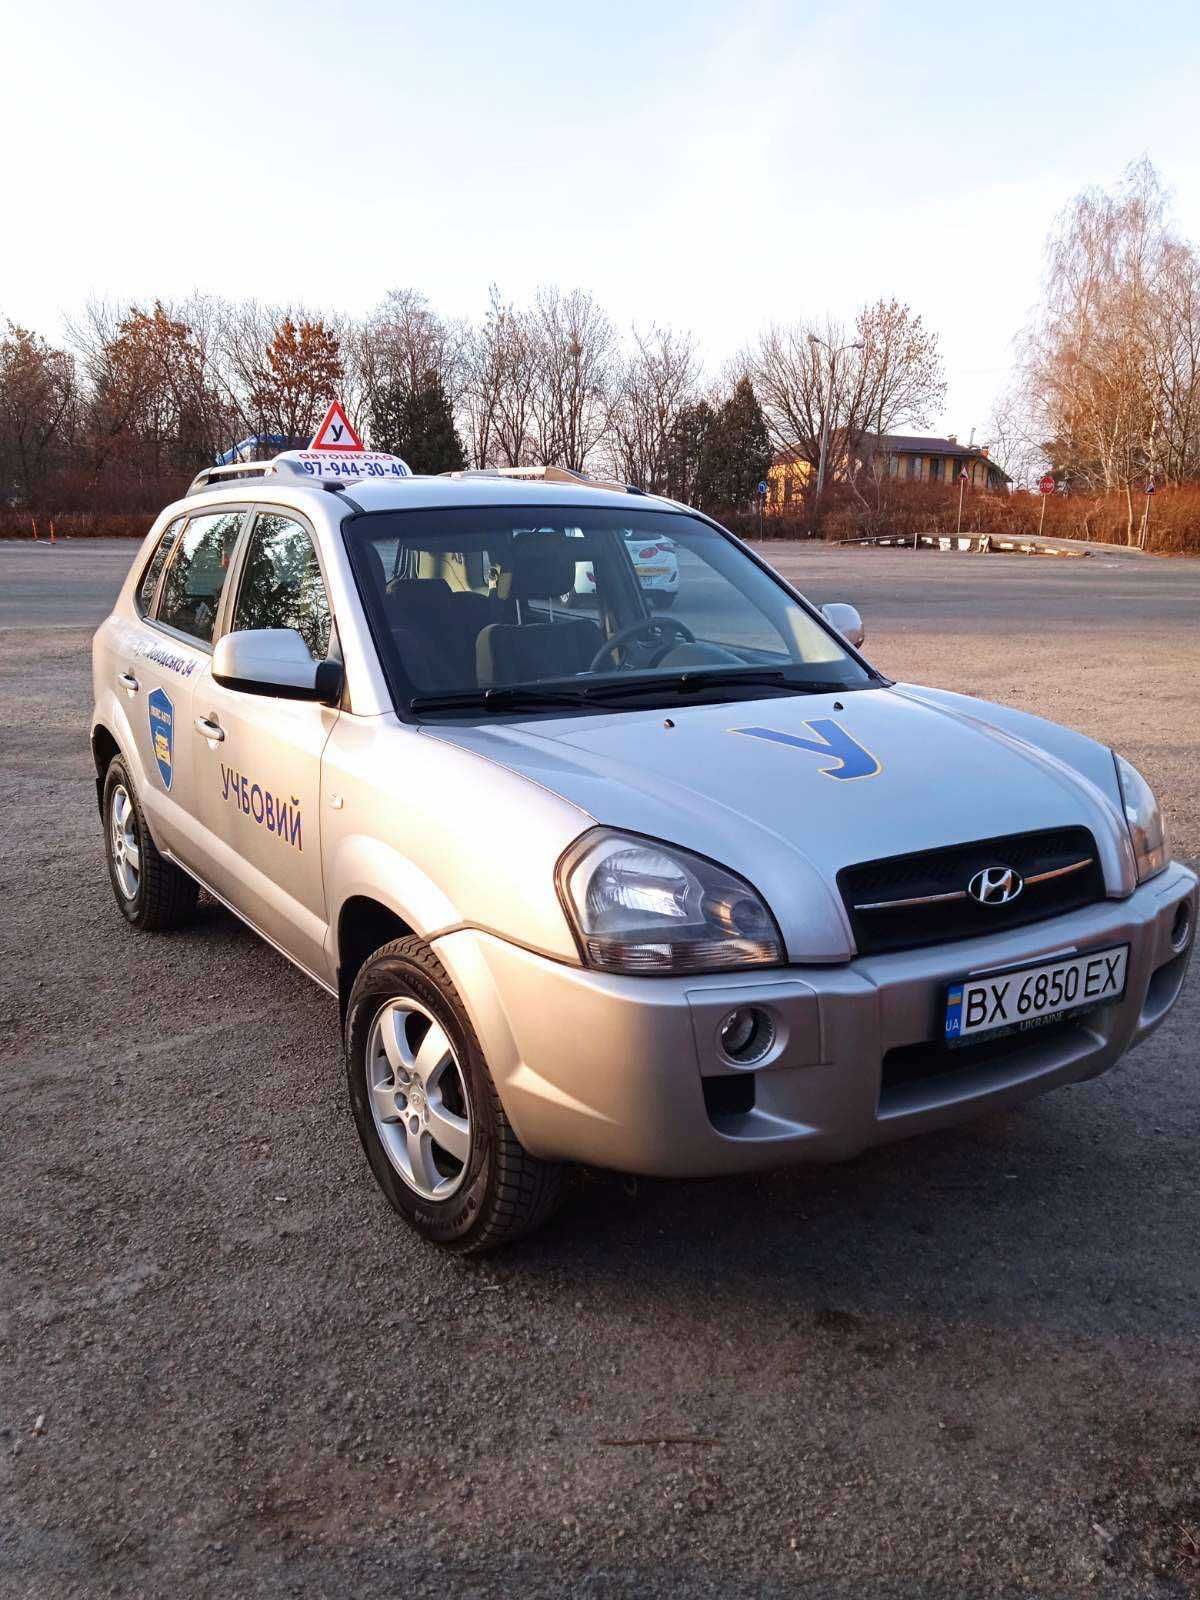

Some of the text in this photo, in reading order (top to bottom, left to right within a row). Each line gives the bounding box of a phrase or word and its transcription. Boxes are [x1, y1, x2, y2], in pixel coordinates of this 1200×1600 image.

[221, 763, 303, 851] УЧБОВИЙ
[945, 1018, 961, 1032] UA
[965, 954, 1121, 1028] BX 6850 EX
